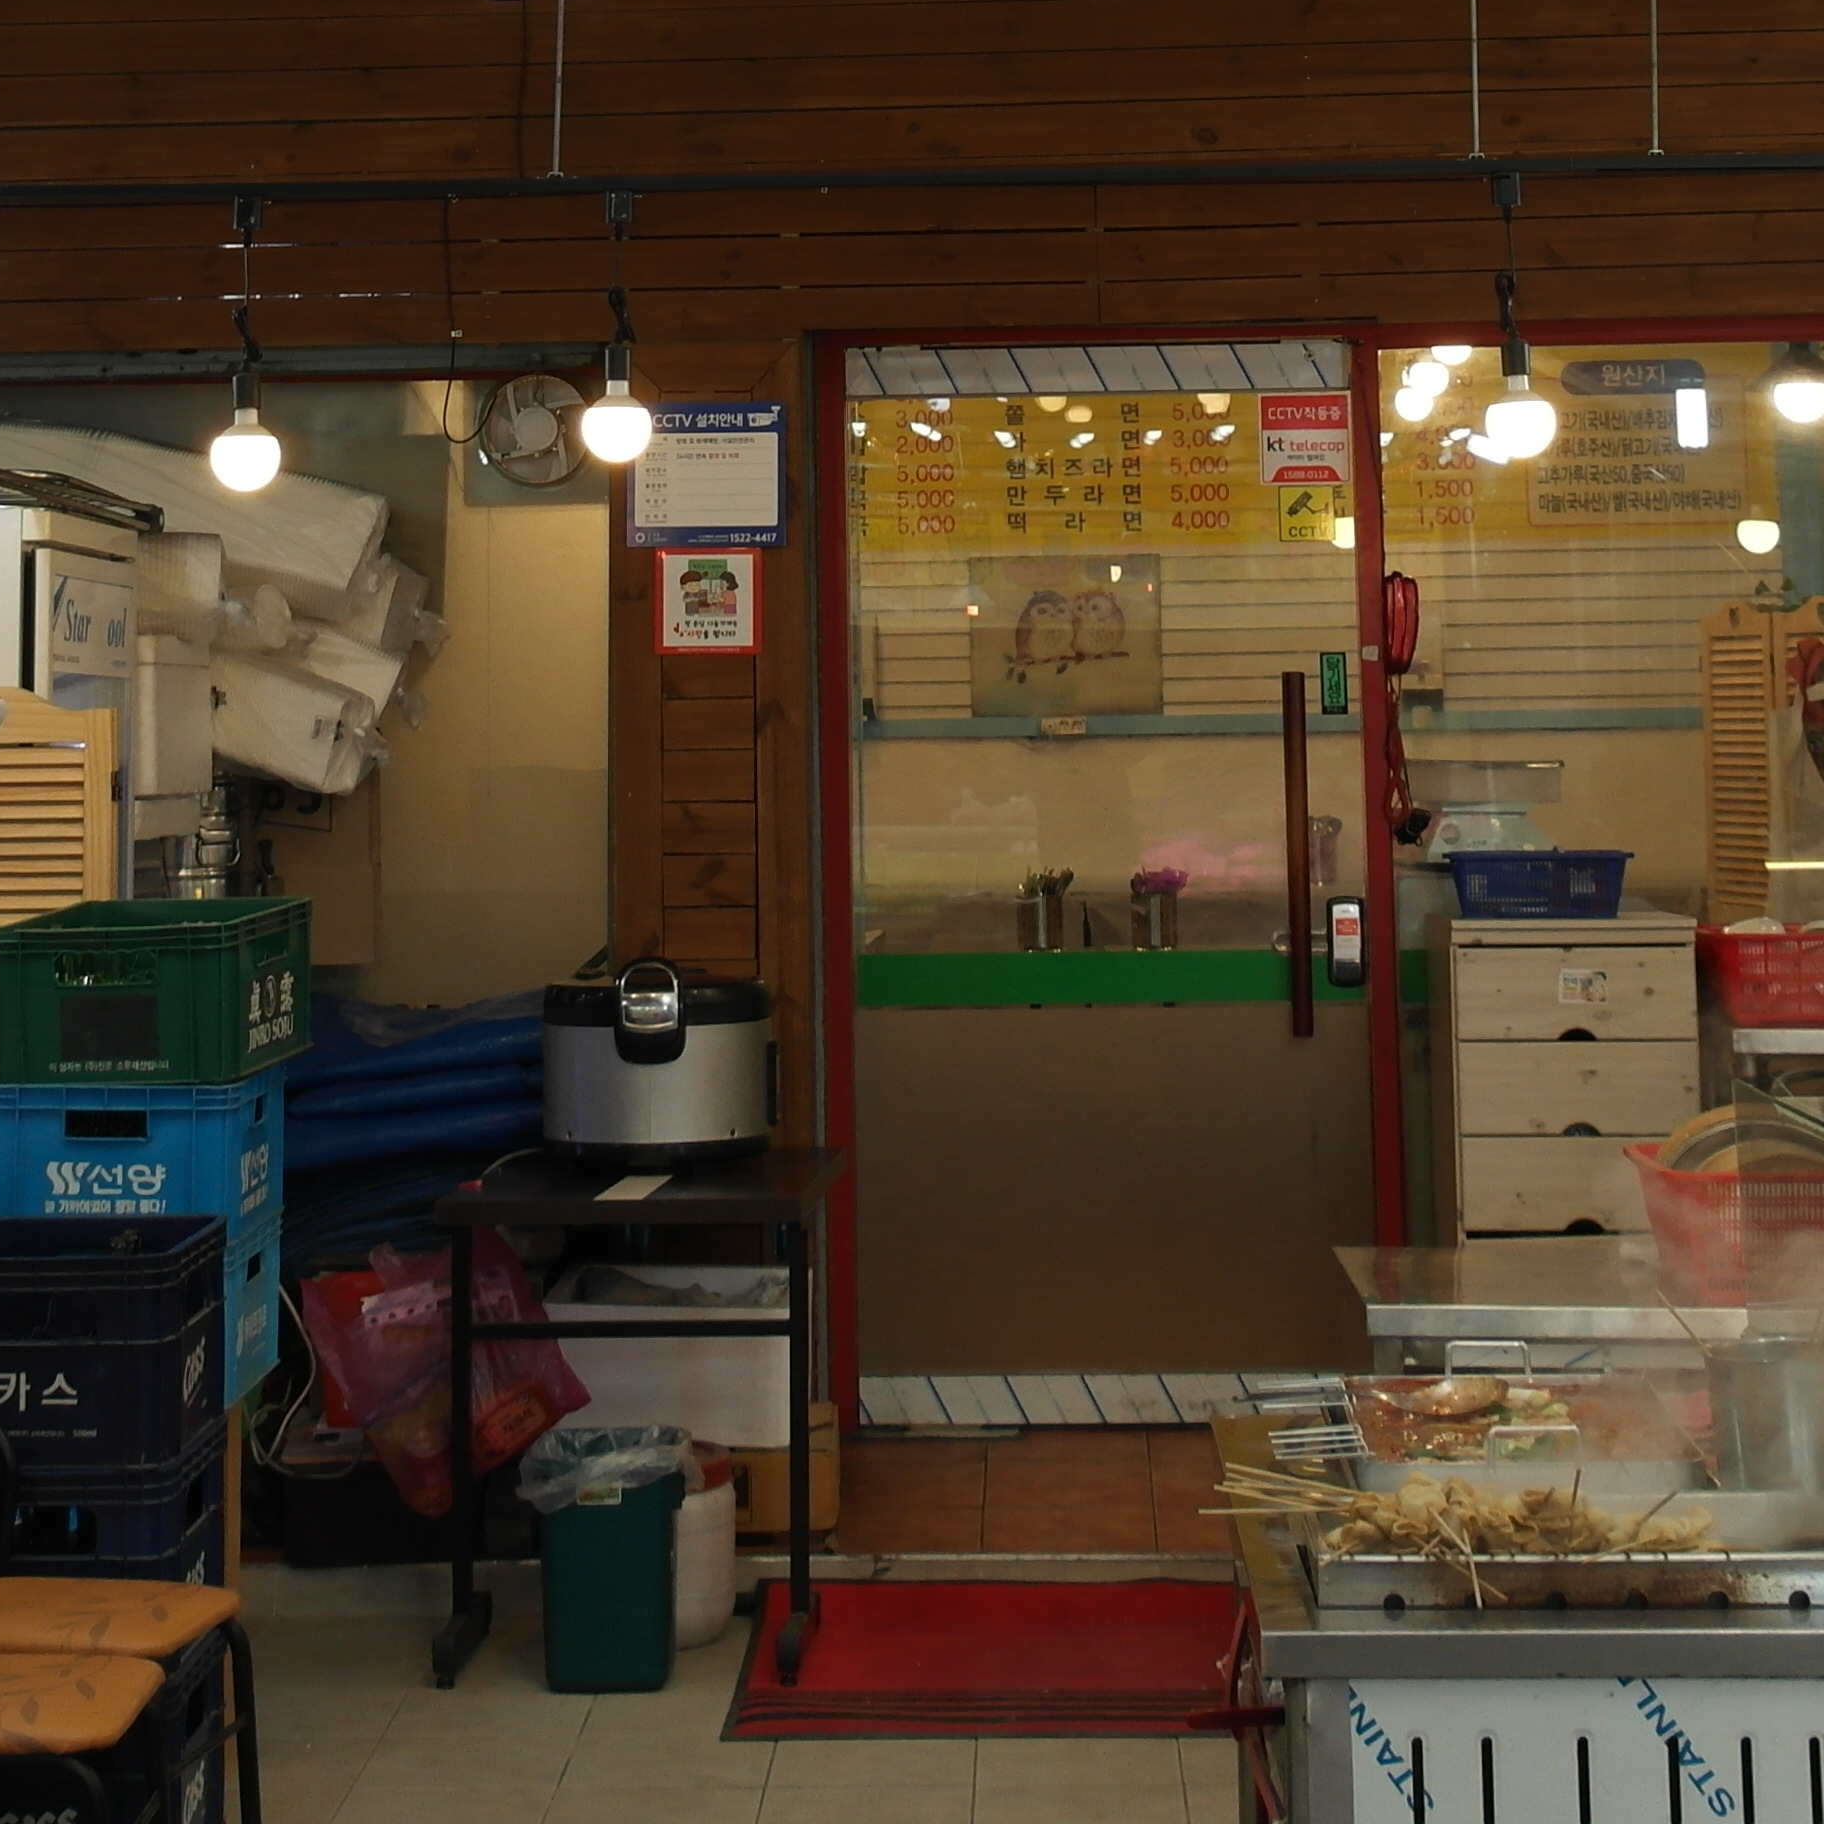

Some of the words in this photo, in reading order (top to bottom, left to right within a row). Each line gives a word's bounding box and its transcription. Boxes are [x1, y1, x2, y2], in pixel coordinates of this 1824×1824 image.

[1602, 364, 1665, 387] 원산지
[653, 414, 693, 427] CCTV
[696, 413, 744, 428] 설치안내
[1268, 405, 1342, 422] CCTV작동중
[896, 435, 954, 456] 2,000
[1267, 436, 1285, 453] kt
[1290, 439, 1345, 455] telecop
[896, 464, 955, 485] 5,000
[1005, 456, 1141, 479] 햄치즈라면
[1170, 456, 1229, 477] 5,000
[1283, 468, 1330, 480] 1588-0112
[1007, 483, 1142, 507] 만두라면
[1171, 483, 1230, 504] 5,000
[1416, 478, 1475, 500] 1,500
[897, 490, 955, 510] 5,000
[897, 515, 956, 536] 5,000
[1171, 510, 1231, 531] 4,000
[1416, 505, 1476, 528] 1,500
[730, 532, 777, 543] 1522-4417
[1288, 525, 1332, 539] CCTV
[64, 598, 92, 644] Star
[272, 1013, 294, 1041] SOJU
[86, 1163, 166, 1195] 선양
[1616, 1676, 1736, 1818] STAINL
